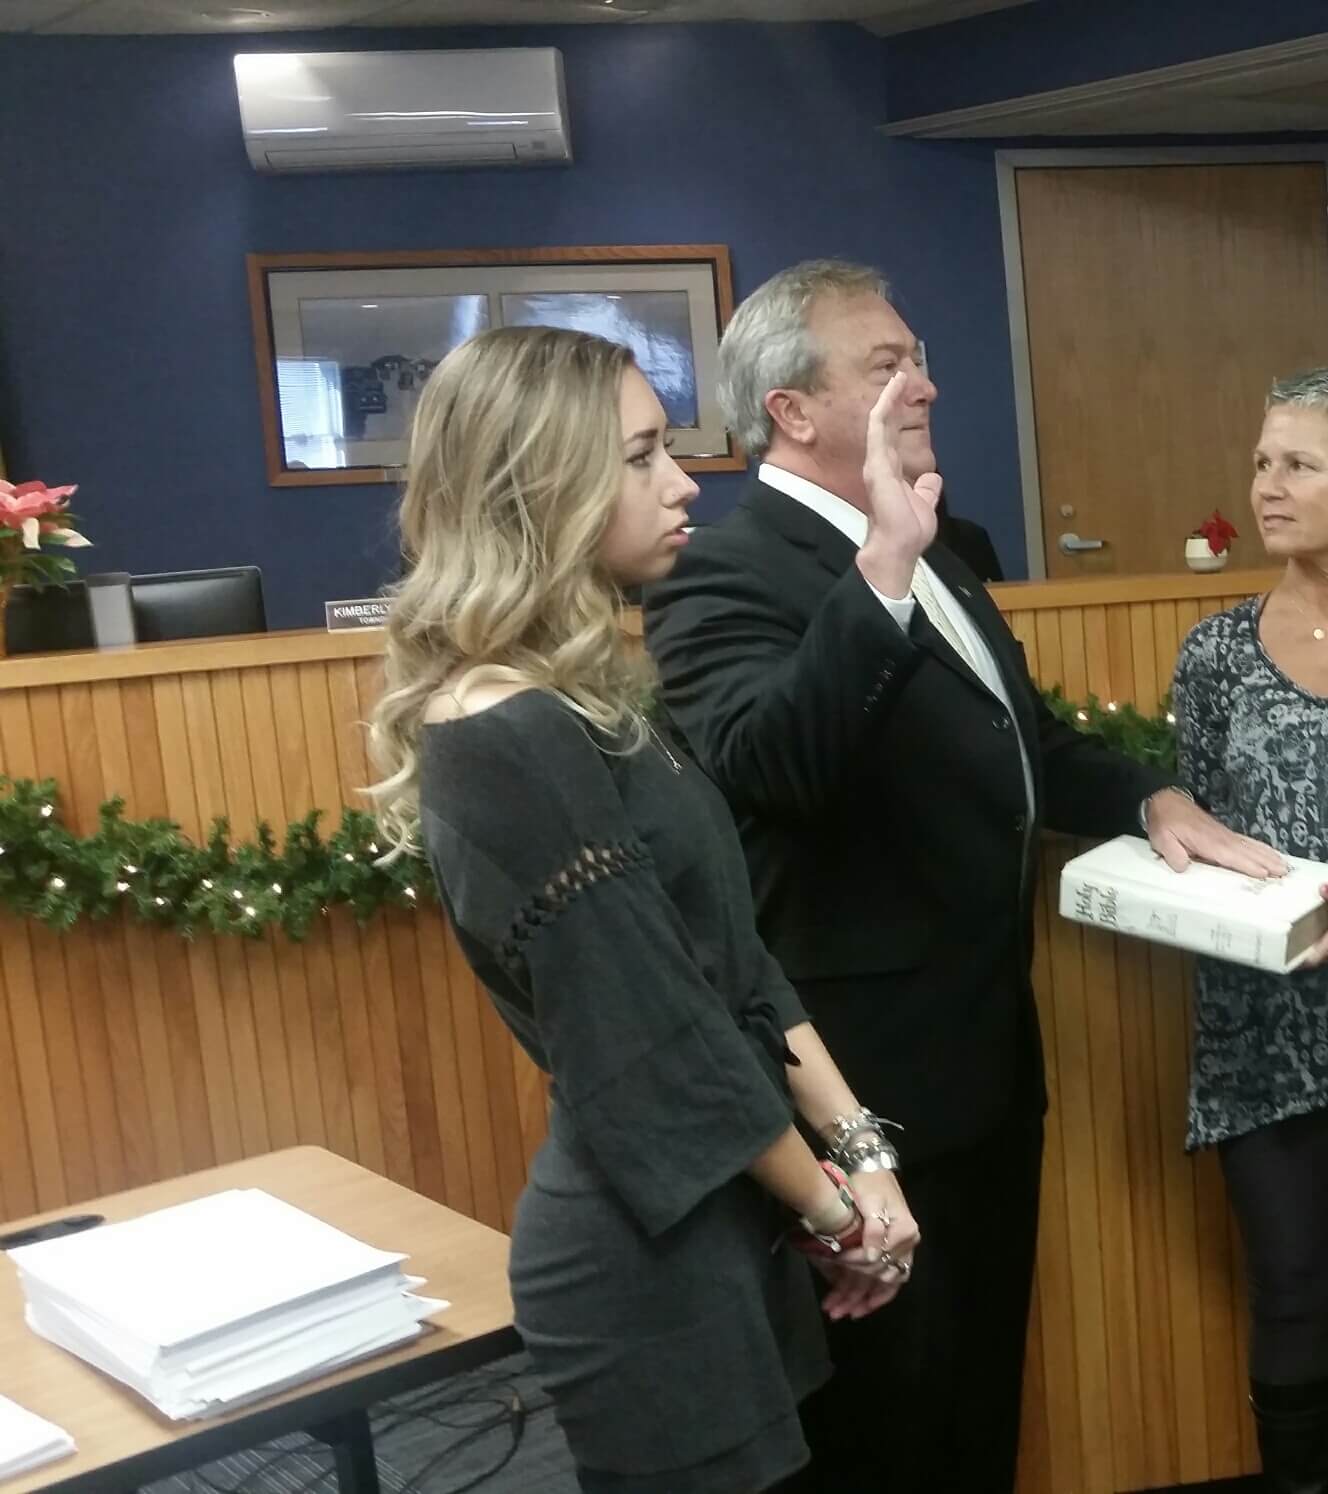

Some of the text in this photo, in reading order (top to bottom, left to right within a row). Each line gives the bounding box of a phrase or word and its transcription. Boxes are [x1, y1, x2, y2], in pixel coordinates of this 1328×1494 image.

[334, 604, 390, 617] KIMBERLY
[1075, 882, 1099, 920] Holy
[1100, 887, 1119, 929] Bible
